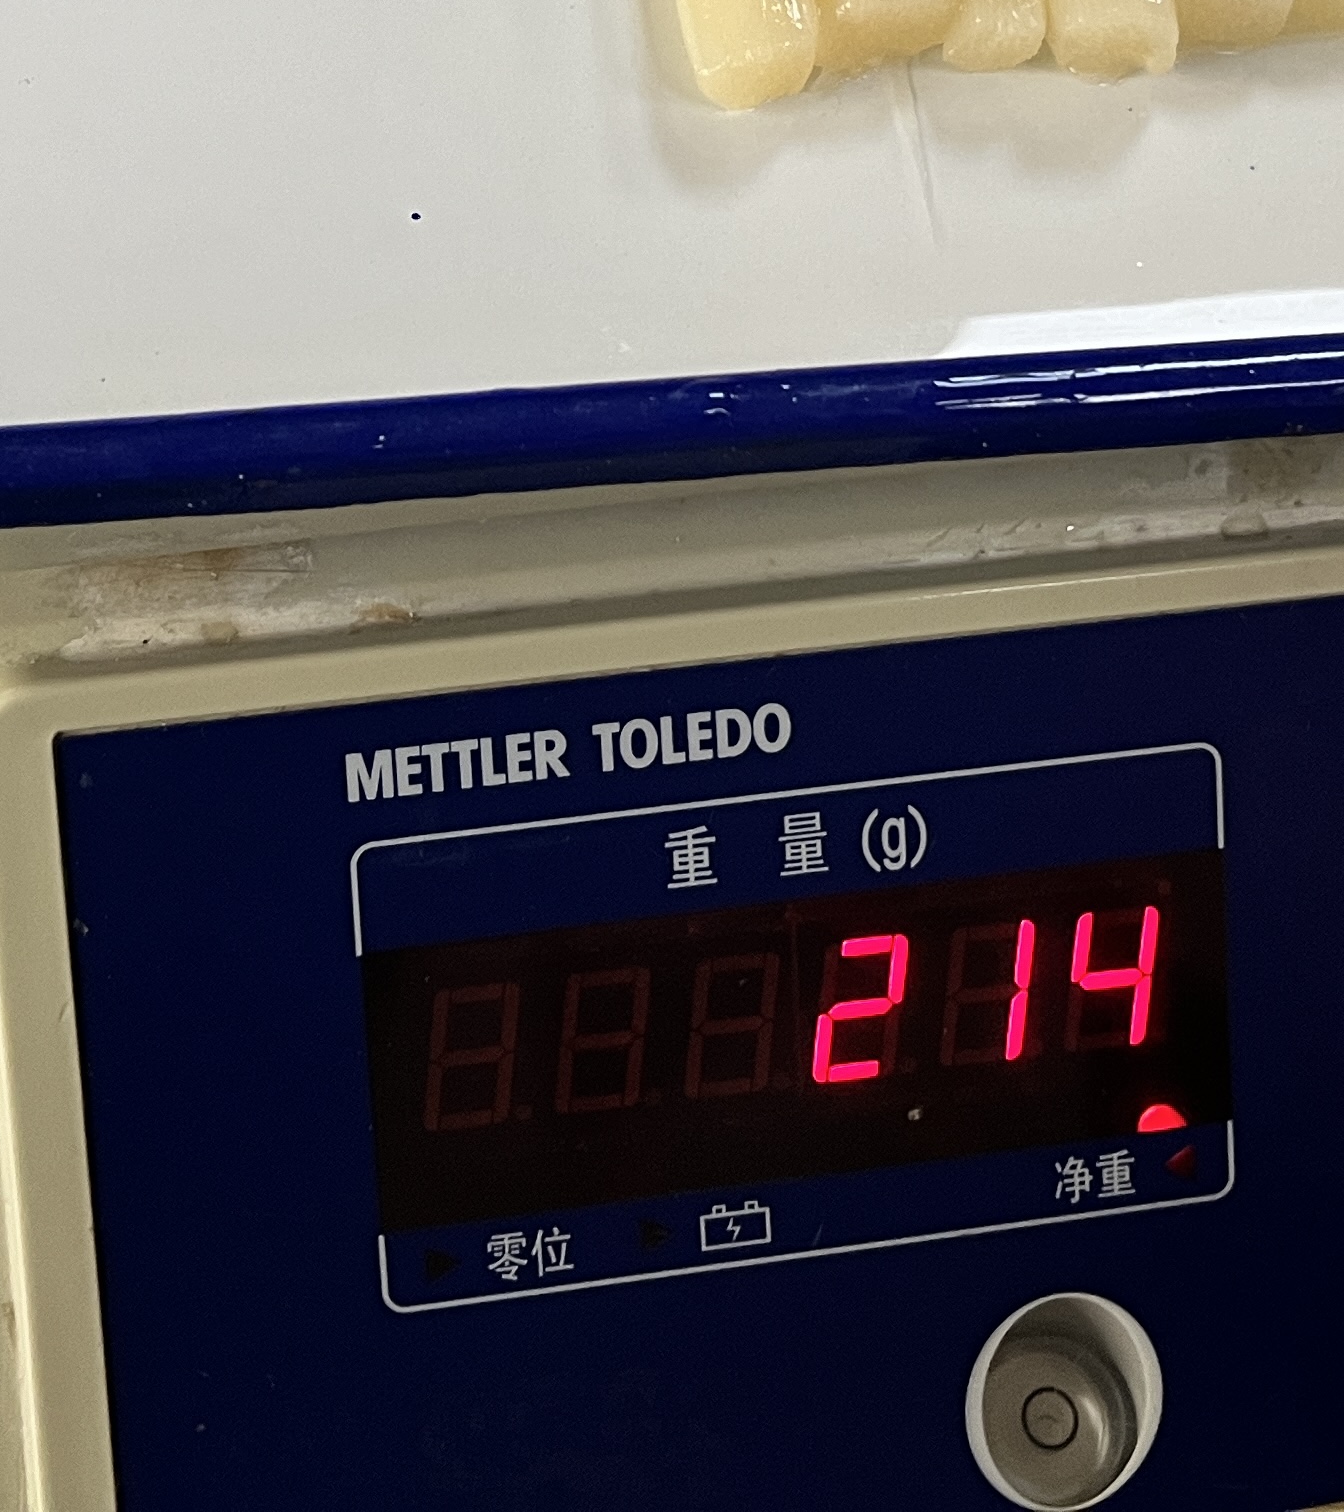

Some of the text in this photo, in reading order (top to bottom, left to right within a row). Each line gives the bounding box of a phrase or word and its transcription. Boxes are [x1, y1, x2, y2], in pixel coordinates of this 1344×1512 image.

[344, 702, 793, 803] METTLER TOLEDO
[812, 906, 1160, 1083] 214
[1054, 1149, 1136, 1204] 净重
[487, 1227, 575, 1281] 零位
